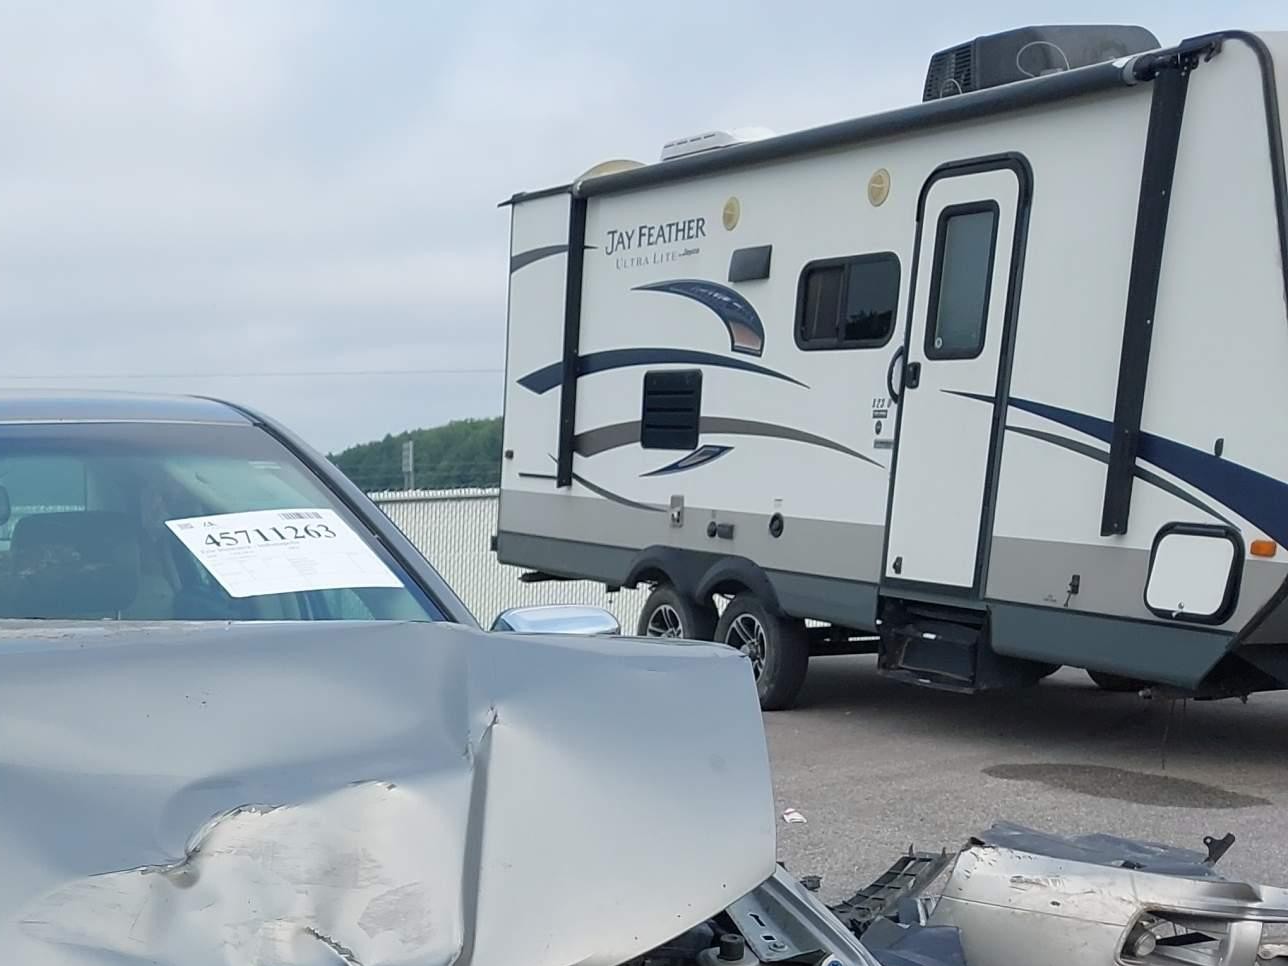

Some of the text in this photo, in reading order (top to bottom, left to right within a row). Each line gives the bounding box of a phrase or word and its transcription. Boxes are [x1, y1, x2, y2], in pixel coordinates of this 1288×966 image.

[605, 217, 706, 255] JAY FEATHER
[205, 524, 337, 547] 45711263
